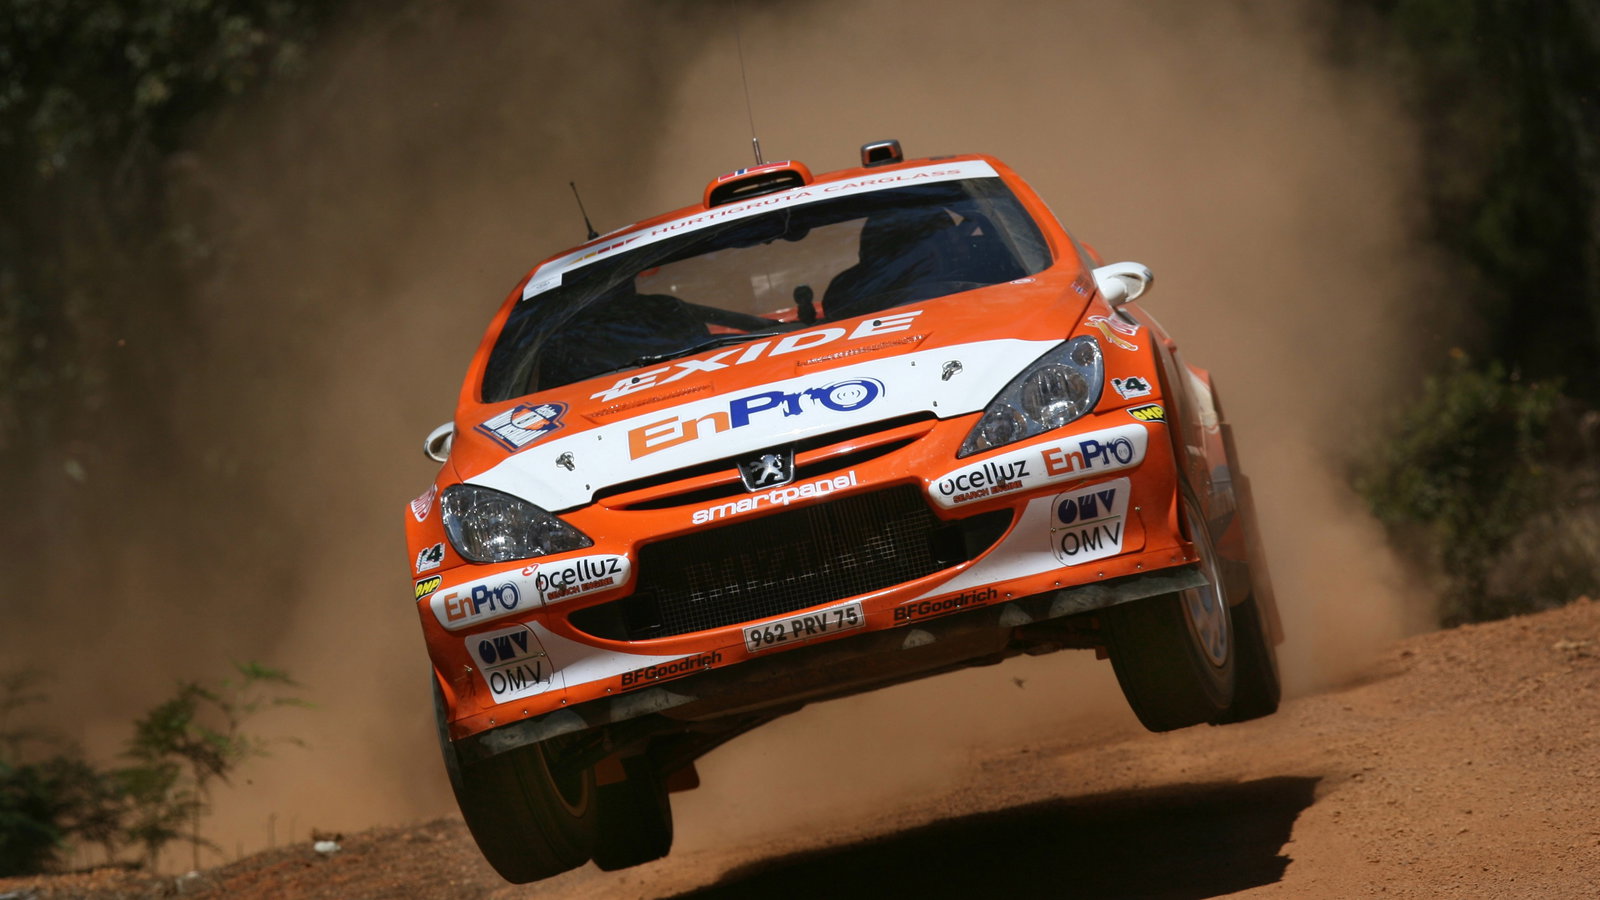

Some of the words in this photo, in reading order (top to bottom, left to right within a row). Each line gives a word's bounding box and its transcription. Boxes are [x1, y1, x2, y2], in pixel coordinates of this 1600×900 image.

[651, 189, 813, 237] HURTIGRUTA
[823, 169, 961, 194] CARGLASS
[589, 310, 924, 403] EXIDE
[627, 376, 886, 461] EnPro
[1132, 407, 1164, 421] OMP
[1041, 435, 1136, 477] EnPro
[692, 471, 857, 525] smartpanel
[953, 488, 990, 504] SEARCH
[991, 479, 1023, 495] ENGINE
[1061, 522, 1121, 556] OMV
[535, 557, 622, 593] ocelluz
[582, 576, 614, 591] ENGINE
[444, 581, 521, 622] EnPro
[893, 586, 998, 622] BFGoodrich
[750, 622, 788, 648] 962
[791, 612, 828, 639] PRV
[833, 606, 860, 629] 75
[489, 660, 541, 695] OMV
[620, 650, 723, 687] BFGoodrich
